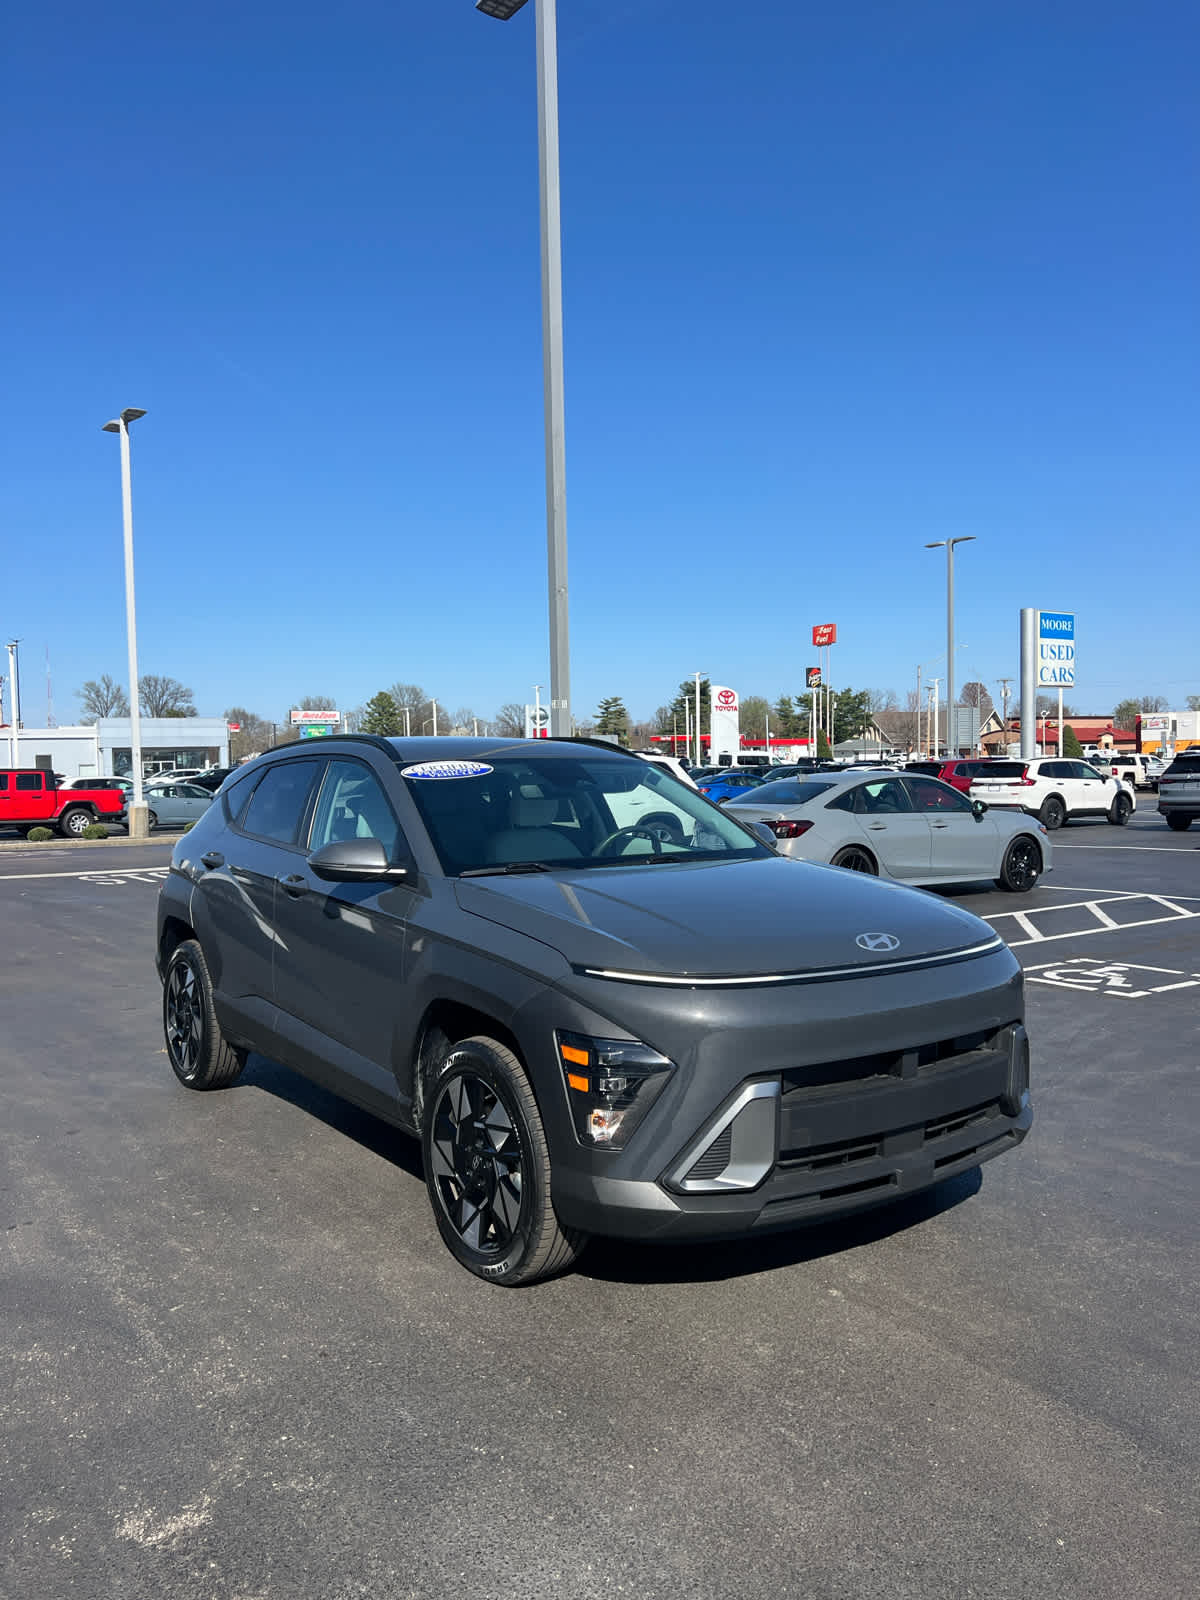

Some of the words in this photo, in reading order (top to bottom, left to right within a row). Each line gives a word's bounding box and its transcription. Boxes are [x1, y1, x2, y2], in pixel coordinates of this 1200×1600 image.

[1041, 618, 1073, 631] MOORE
[1040, 643, 1074, 661] USED
[1040, 665, 1074, 683] CARS
